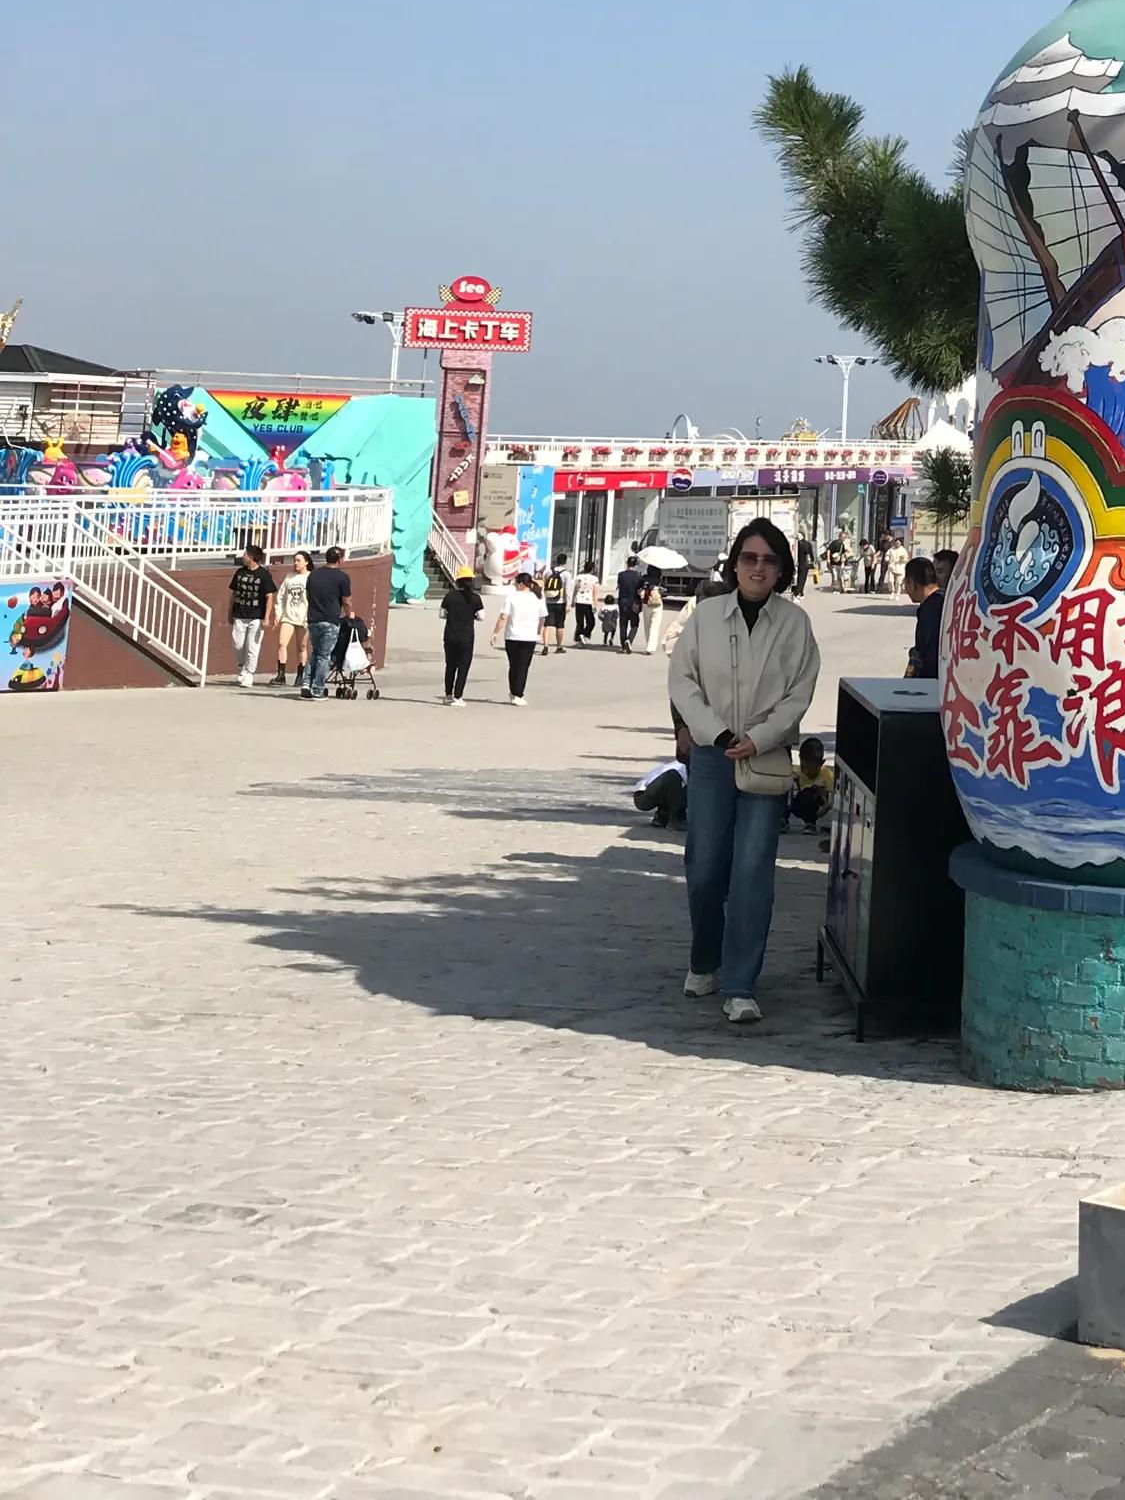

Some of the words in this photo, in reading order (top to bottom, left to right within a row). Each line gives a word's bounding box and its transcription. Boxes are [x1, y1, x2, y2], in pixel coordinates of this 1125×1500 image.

[417, 317, 520, 341] 海上卡丁车
[252, 423, 273, 433] YES
[276, 424, 304, 434] CLUB
[449, 453, 476, 482] KART
